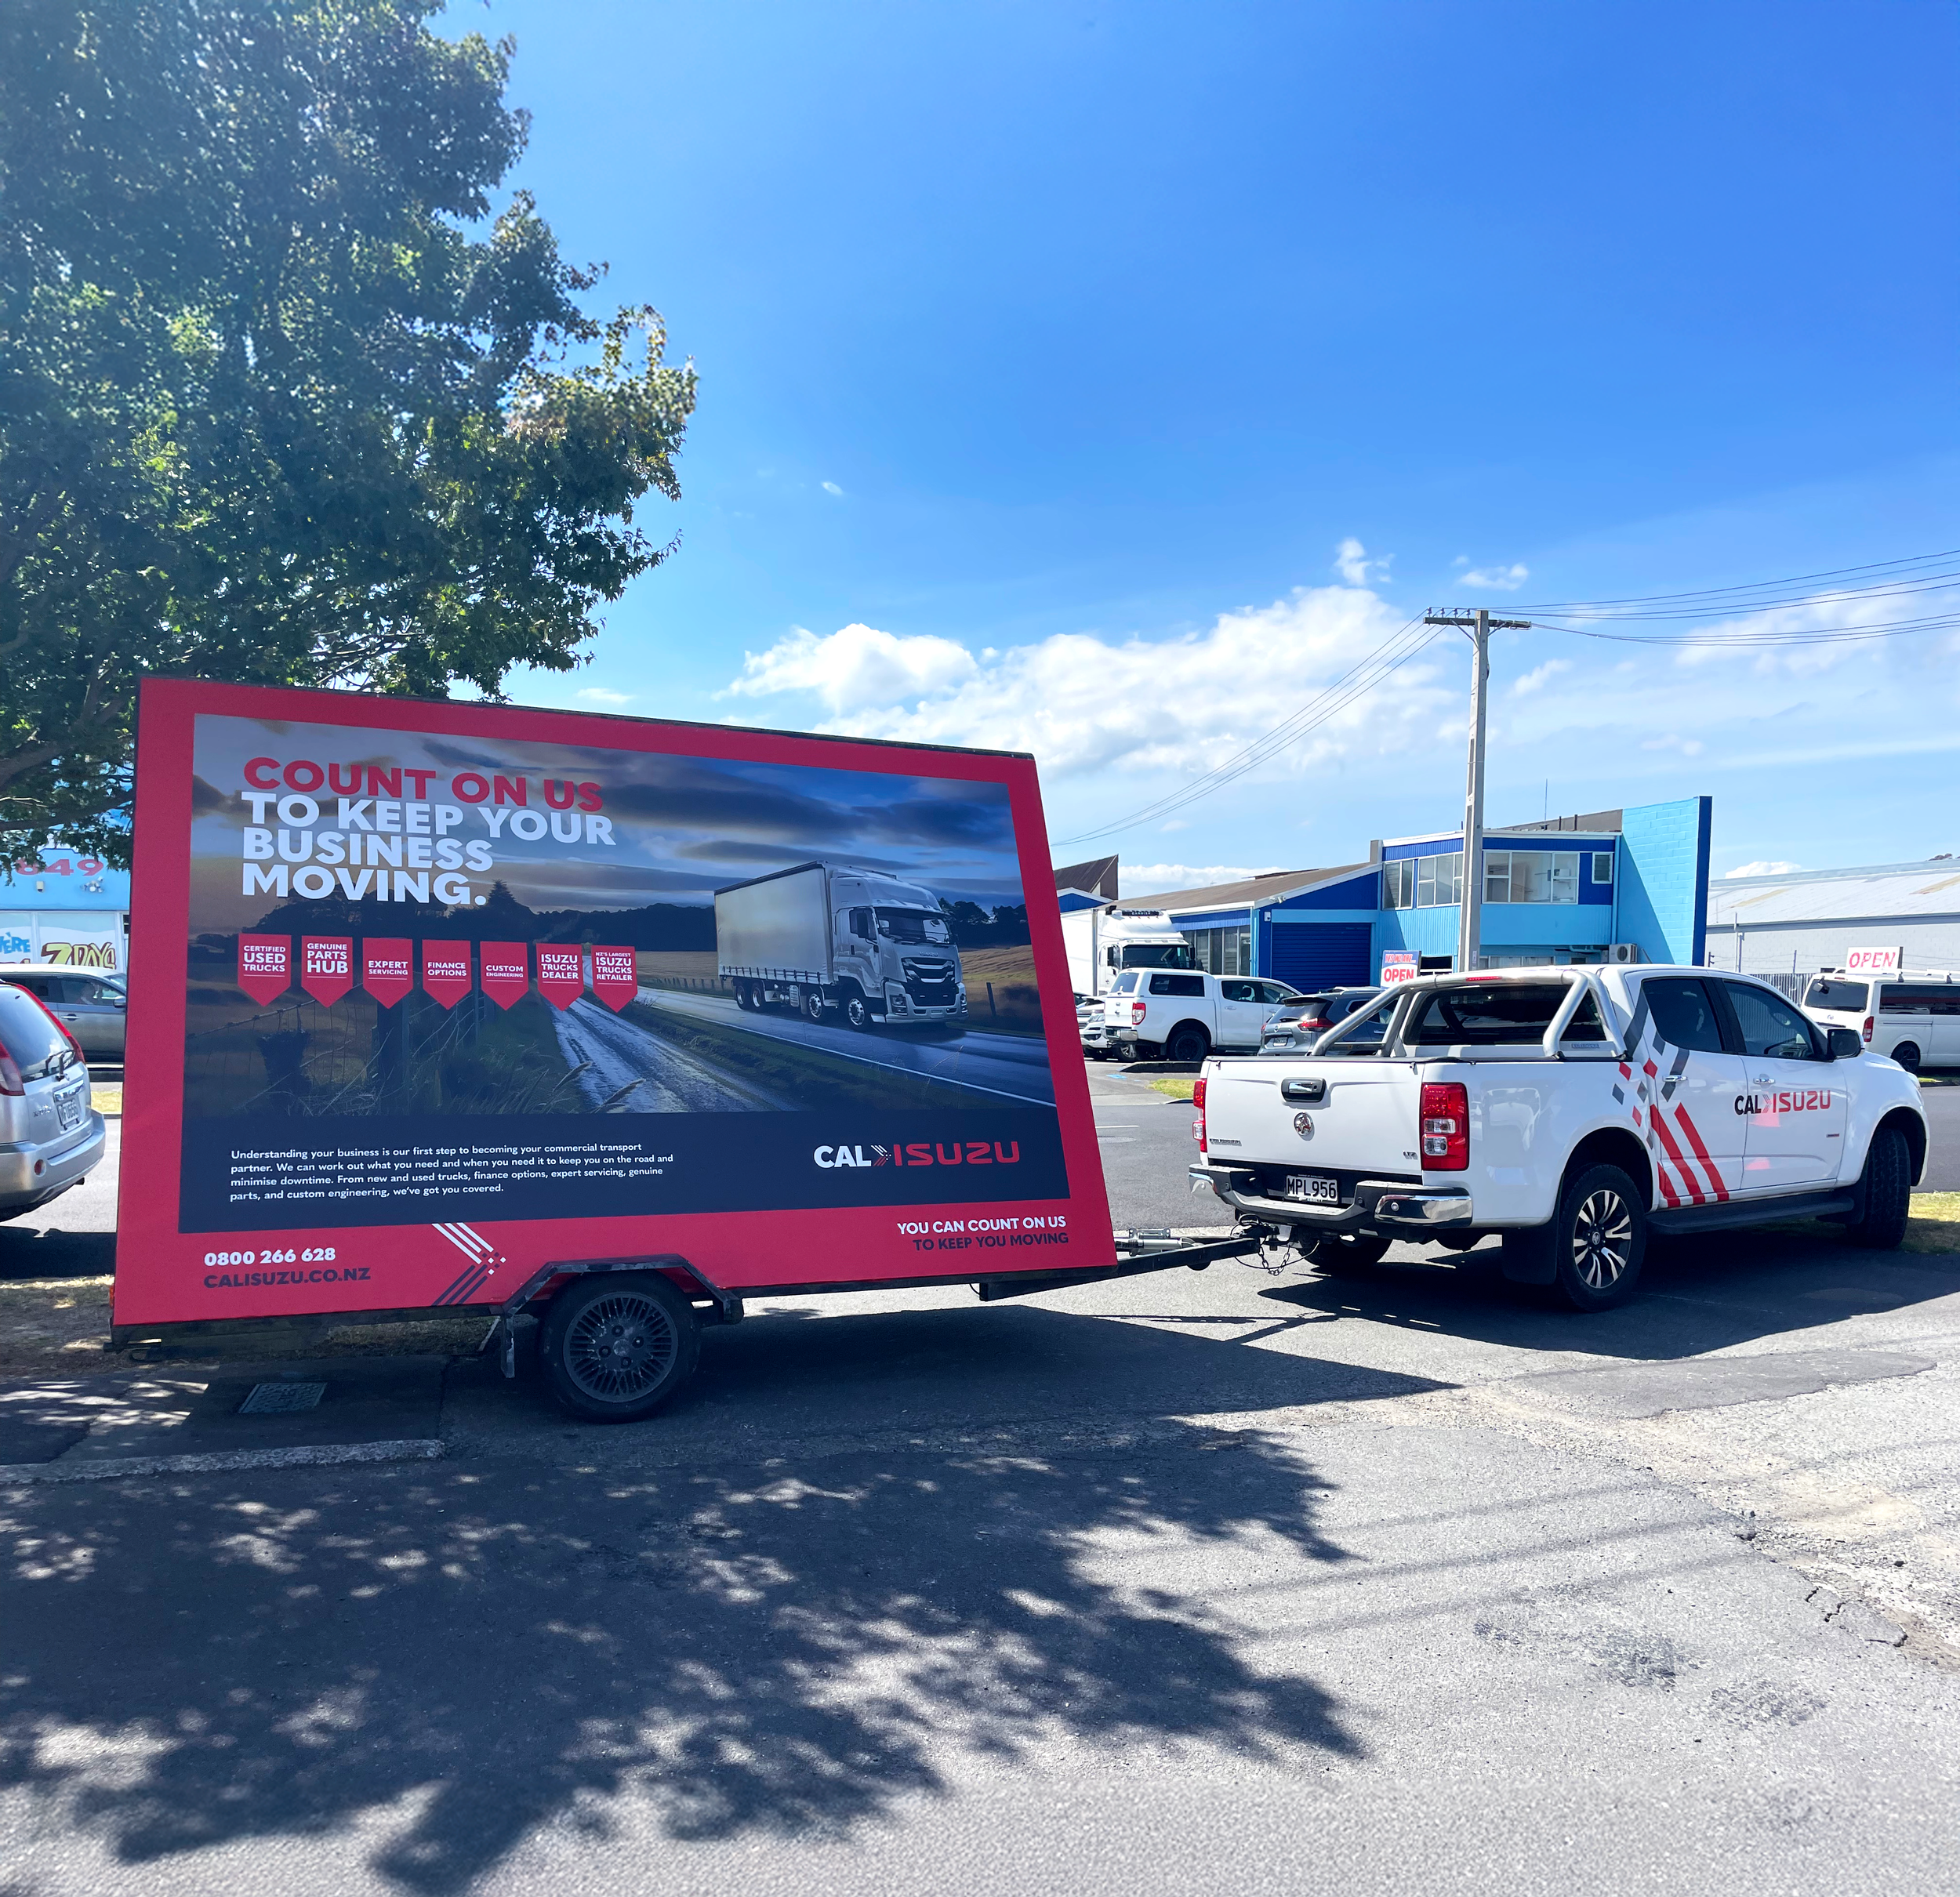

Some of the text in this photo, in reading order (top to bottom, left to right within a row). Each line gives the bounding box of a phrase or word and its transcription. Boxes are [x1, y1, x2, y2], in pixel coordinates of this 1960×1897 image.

[243, 757, 604, 811] COUNT ON US
[241, 792, 616, 846] TO KEEP YOUR
[242, 827, 493, 872] BUSINESS
[241, 863, 487, 906] MOVING.
[41, 942, 72, 964] 7
[244, 953, 286, 963] USED
[307, 951, 347, 960] PARTS
[541, 954, 578, 963] ISUZU
[596, 957, 632, 967] ISUZU
[1849, 952, 1896, 969] OPEN
[307, 960, 348, 974] HUB
[368, 960, 408, 969] EXPERT
[1384, 968, 1414, 982] OPEN
[1734, 1090, 1831, 1115] CAL ISUZU
[231, 1150, 308, 1160] Understanding
[311, 1151, 334, 1160] your
[337, 1148, 379, 1157] business
[382, 1148, 390, 1156] is
[412, 1147, 433, 1155] first
[435, 1147, 456, 1157] step
[459, 1146, 470, 1155] to
[472, 1145, 518, 1155] becoming
[521, 1146, 542, 1155] your
[544, 1144, 597, 1152] commercial
[600, 1143, 642, 1153] transport
[814, 1141, 1020, 1168] CAL ISUZU
[230, 1164, 273, 1174] partner.
[276, 1163, 294, 1172] We
[318, 1161, 344, 1170] work
[367, 1160, 391, 1170] what
[394, 1162, 412, 1171] you
[415, 1159, 440, 1169] need
[442, 1159, 460, 1168] and
[463, 1158, 488, 1167] when
[492, 1159, 509, 1168] you
[512, 1157, 535, 1166] need
[559, 1156, 582, 1166] keep
[584, 1157, 601, 1166] you
[657, 1154, 673, 1163] and
[230, 1177, 278, 1187] minimise
[280, 1176, 334, 1185] downtime.
[337, 1175, 365, 1184] From
[390, 1173, 409, 1182] and
[412, 1173, 435, 1181] used
[437, 1171, 471, 1181] trucks,
[474, 1170, 509, 1180] finance
[511, 1170, 549, 1180] options,
[551, 1169, 582, 1179] expert
[584, 1168, 626, 1177] servicing,
[629, 1167, 663, 1177] genuine
[230, 1184, 504, 1202] parts, and custom engineering, we've got you covered.
[1287, 1177, 1337, 1199] MPL956
[897, 1215, 1067, 1235] YOU CAN COUNT ON US
[913, 1232, 1069, 1251] TO KEEP YOU MOVING
[204, 1247, 336, 1267] 0800 266 628
[204, 1268, 372, 1288] CALISUZU.CO.NZ
